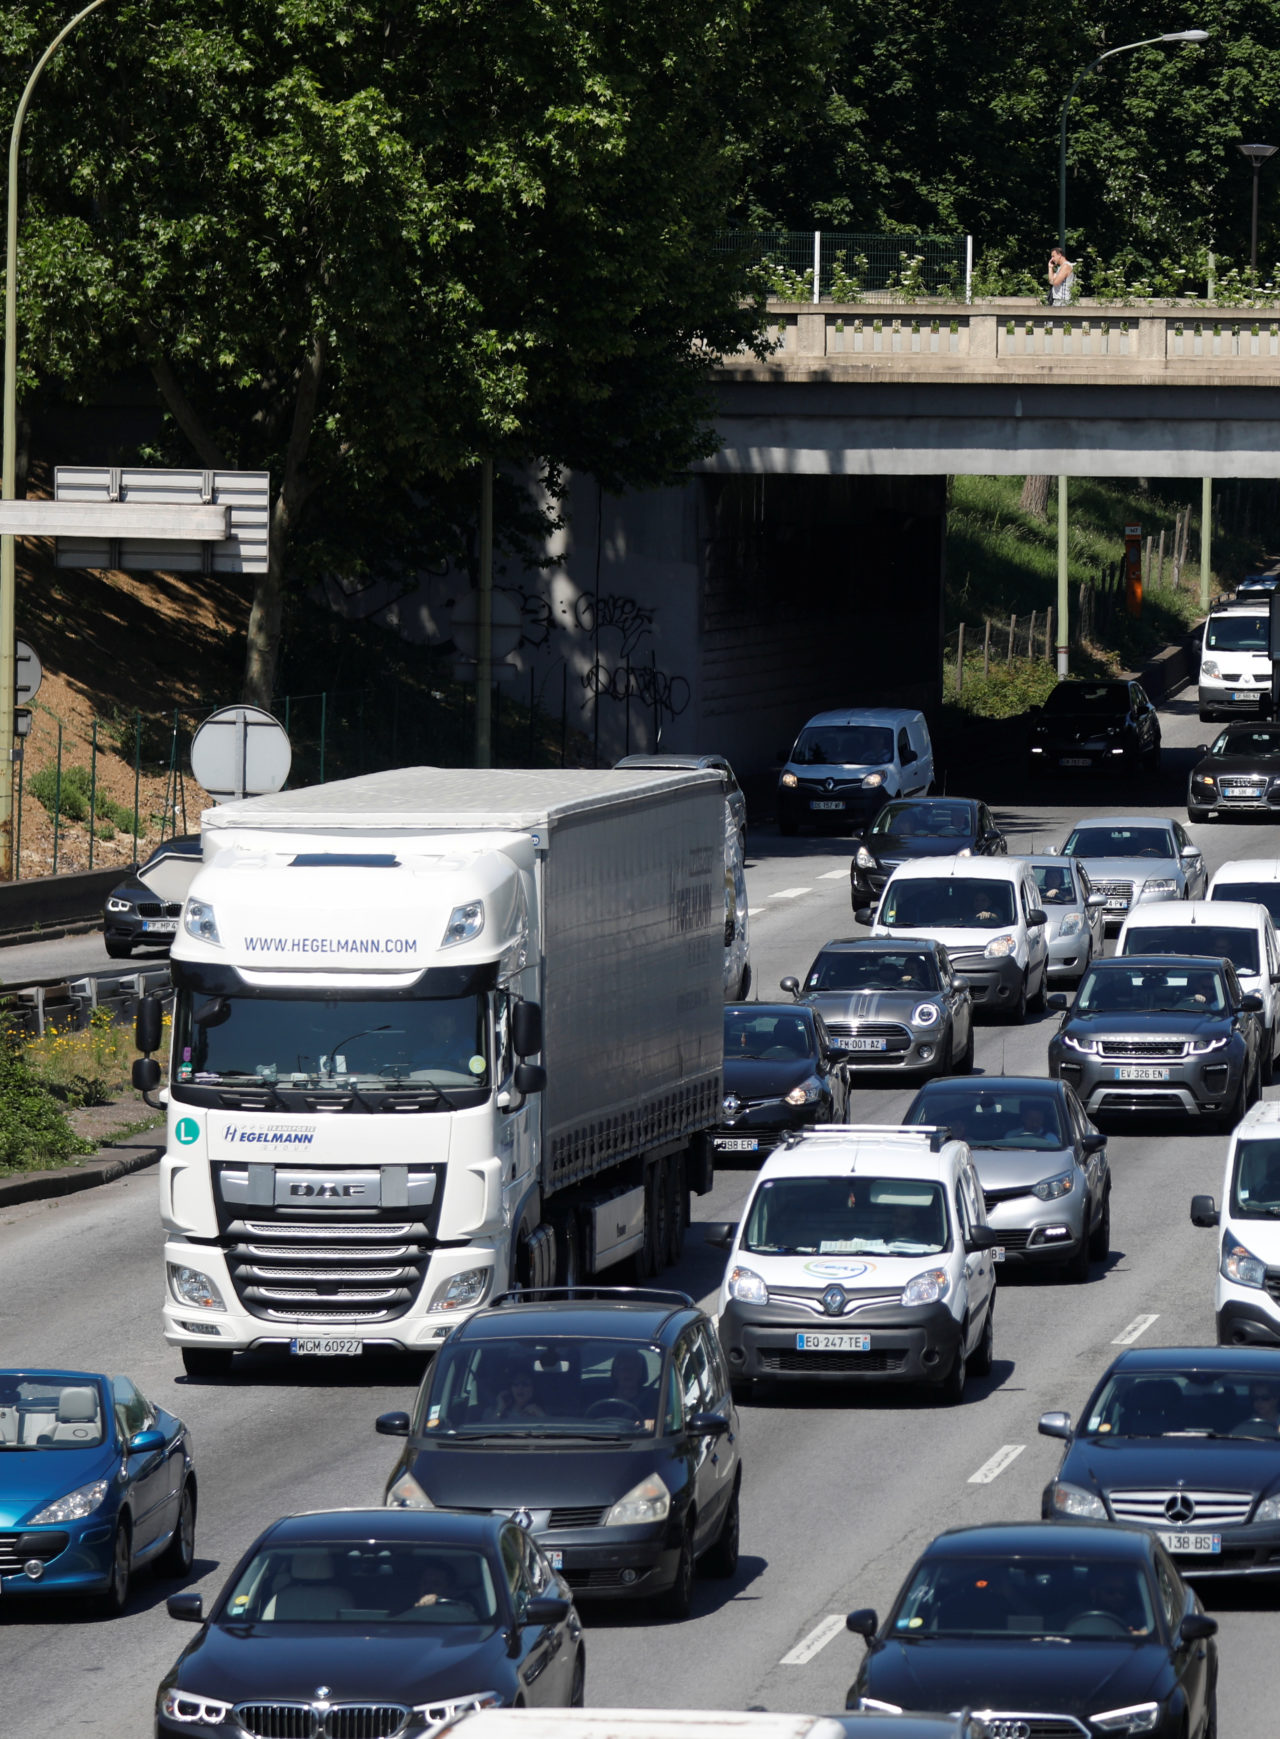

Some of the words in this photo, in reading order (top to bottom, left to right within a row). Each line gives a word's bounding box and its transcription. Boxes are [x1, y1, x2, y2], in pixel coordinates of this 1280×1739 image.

[244, 937, 417, 953] WWW.HEGELMANN.COM
[180, 1122, 193, 1141] L
[289, 1183, 366, 1198] DAF
[298, 1341, 319, 1352] WGM
[324, 1341, 361, 1353] 60927
